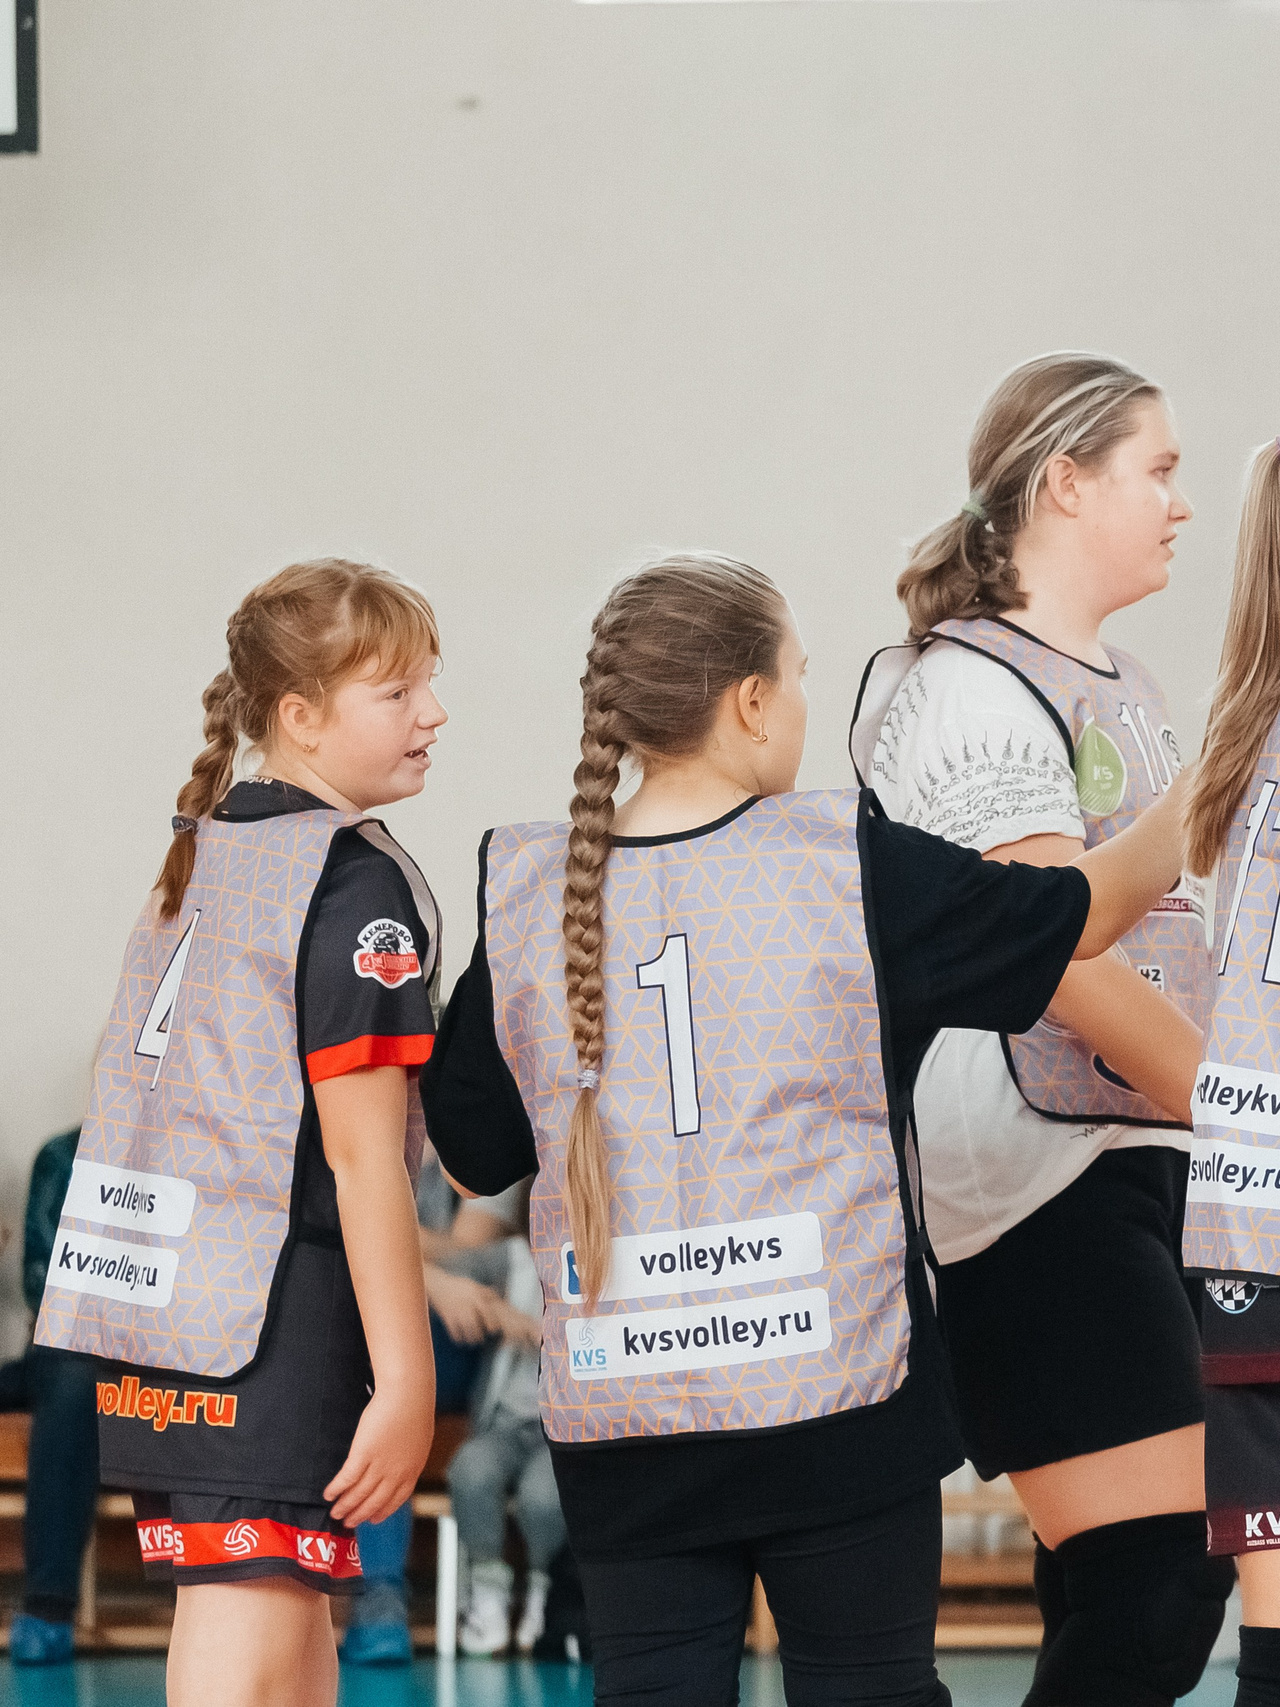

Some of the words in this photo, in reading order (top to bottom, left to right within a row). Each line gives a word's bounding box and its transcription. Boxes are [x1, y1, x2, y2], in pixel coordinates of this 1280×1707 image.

[361, 922, 412, 944] КЕМЕРОВО
[636, 933, 701, 1137] 1
[58, 1241, 158, 1291] kvsvolley.ru
[639, 1235, 783, 1276] volleykvs
[622, 1310, 813, 1357] kvsvolley.ru
[572, 1347, 607, 1367] KVS
[137, 1524, 174, 1551] KVS
